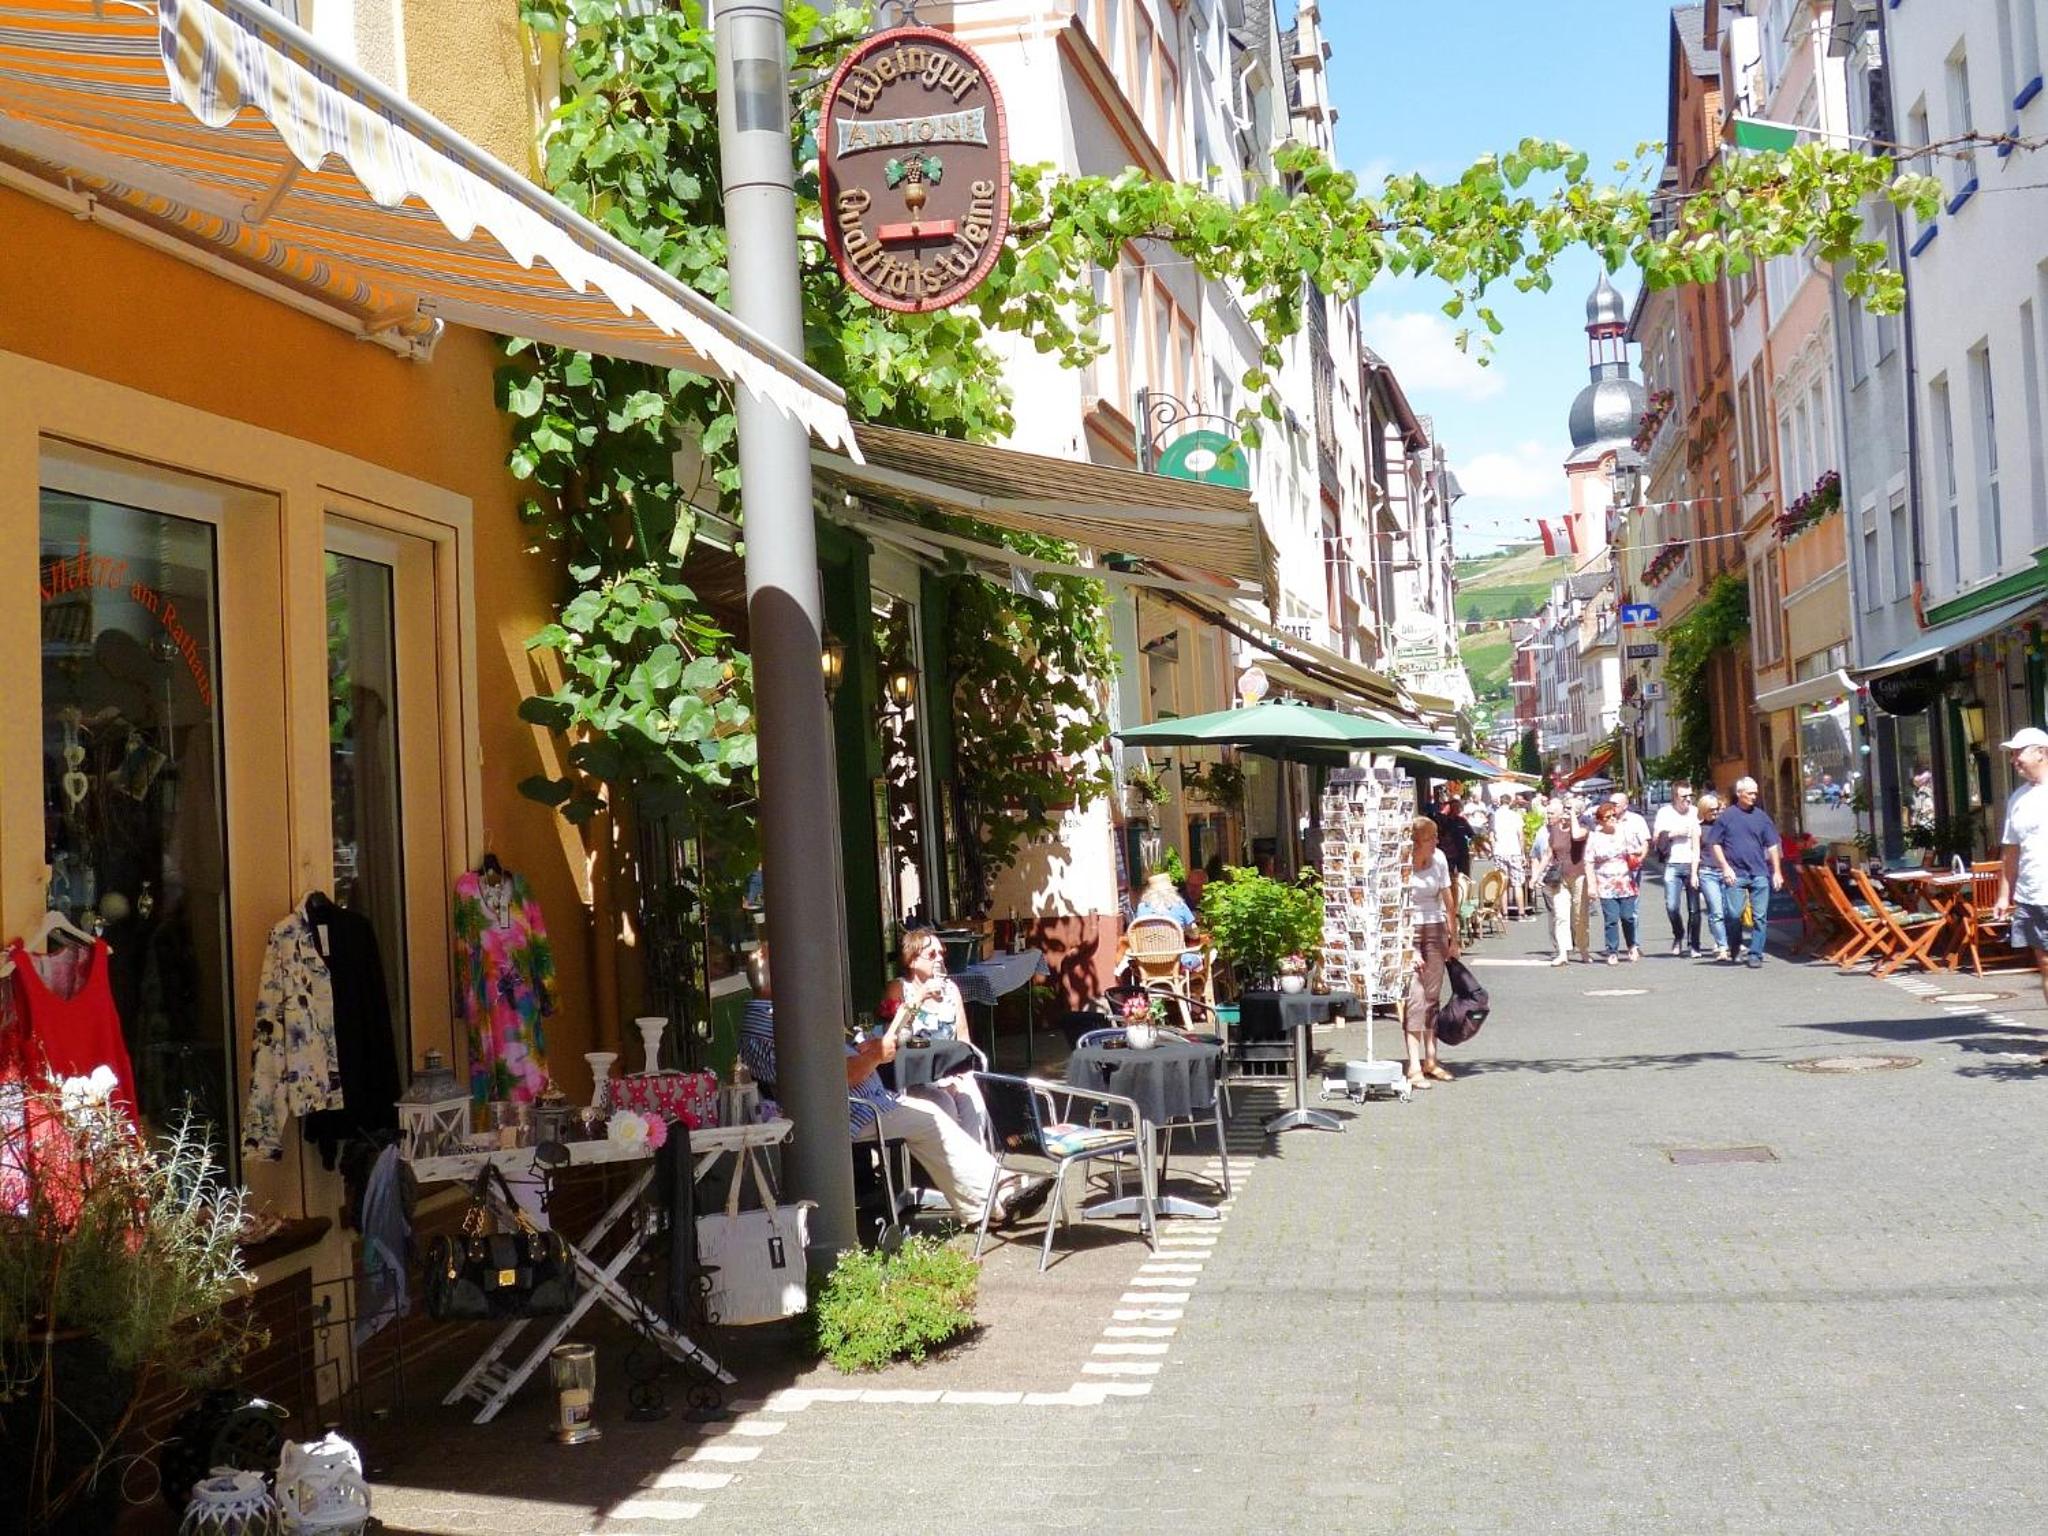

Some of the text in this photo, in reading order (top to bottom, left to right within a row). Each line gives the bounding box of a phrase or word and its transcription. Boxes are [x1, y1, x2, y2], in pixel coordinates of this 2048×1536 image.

[837, 41, 979, 110] Weingut
[130, 581, 159, 614] am
[162, 602, 213, 705] Rathaus
